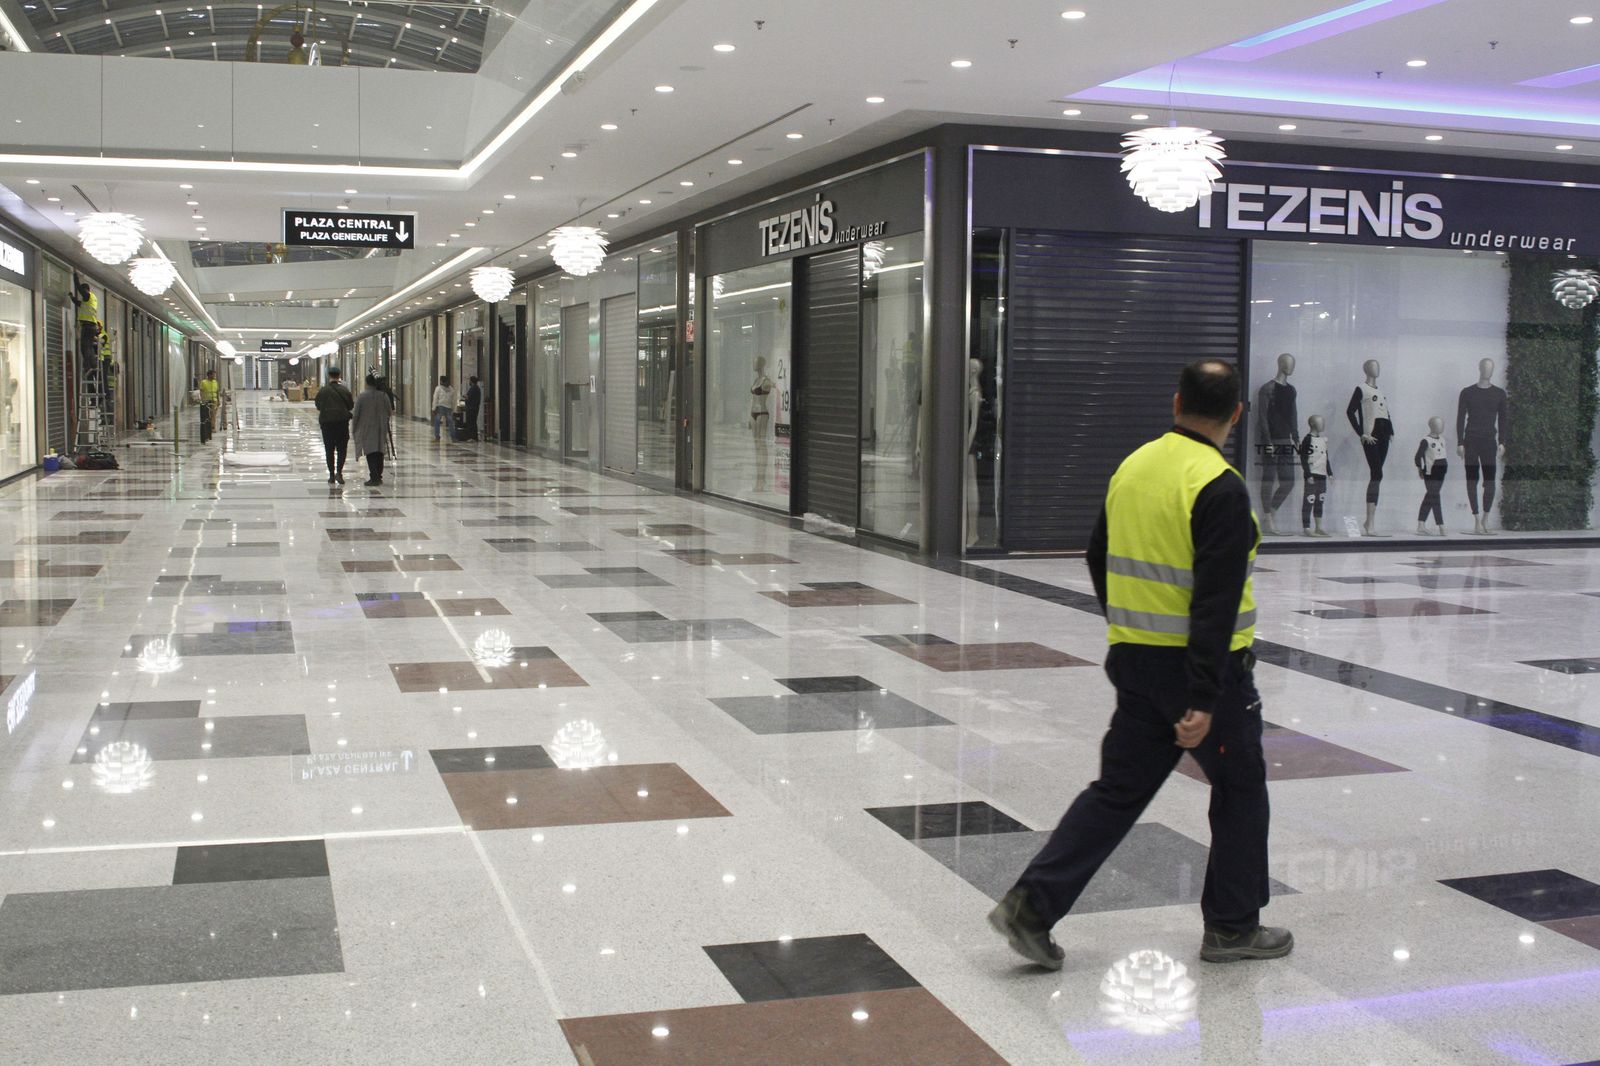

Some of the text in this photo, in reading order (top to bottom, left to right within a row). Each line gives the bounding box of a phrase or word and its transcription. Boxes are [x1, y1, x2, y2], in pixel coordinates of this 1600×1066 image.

[294, 217, 394, 230] PLAZA CENTRAL
[300, 231, 389, 242] PLAZA GENERALIFE
[834, 221, 886, 245] underwear
[1450, 230, 1577, 252] underwear
[1254, 443, 1315, 456] TEZENS
